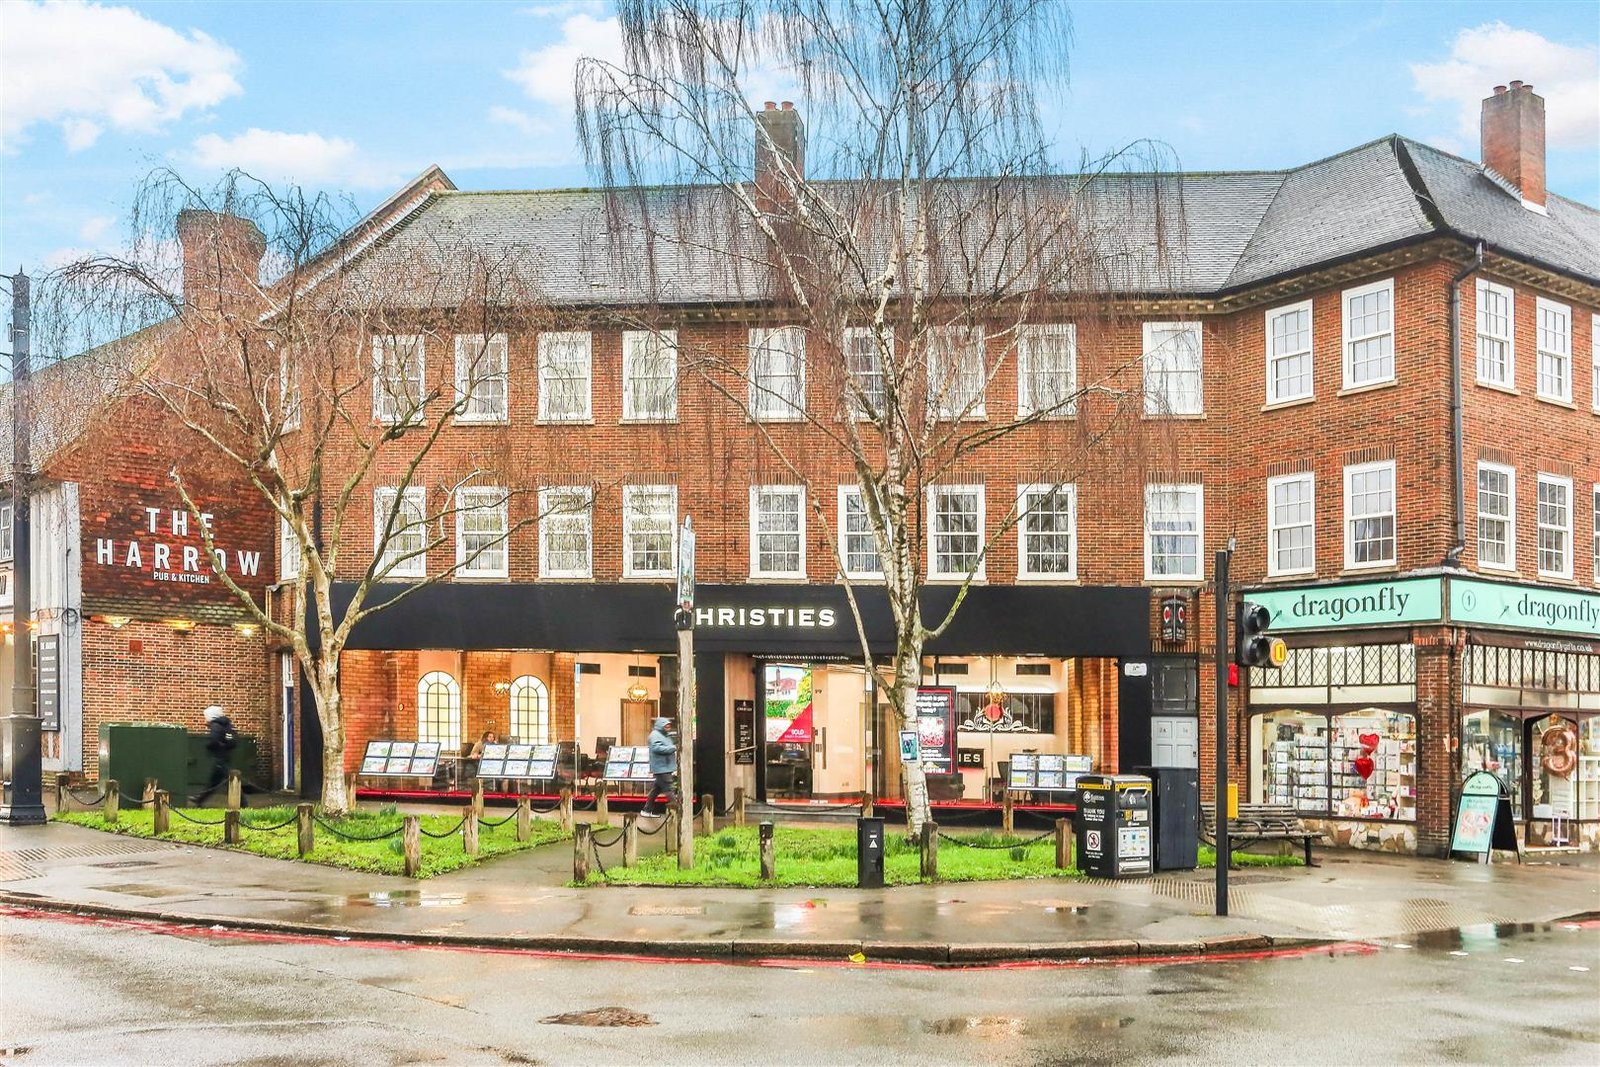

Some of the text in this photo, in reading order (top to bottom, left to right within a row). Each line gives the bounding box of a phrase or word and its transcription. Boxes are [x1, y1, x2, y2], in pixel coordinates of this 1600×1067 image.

[145, 507, 214, 539] THE
[97, 538, 260, 577] HARROW
[153, 571, 210, 584] PUB & KITCHEN
[1292, 586, 1410, 622] dragonfly
[1517, 593, 1600, 629] dragonfly
